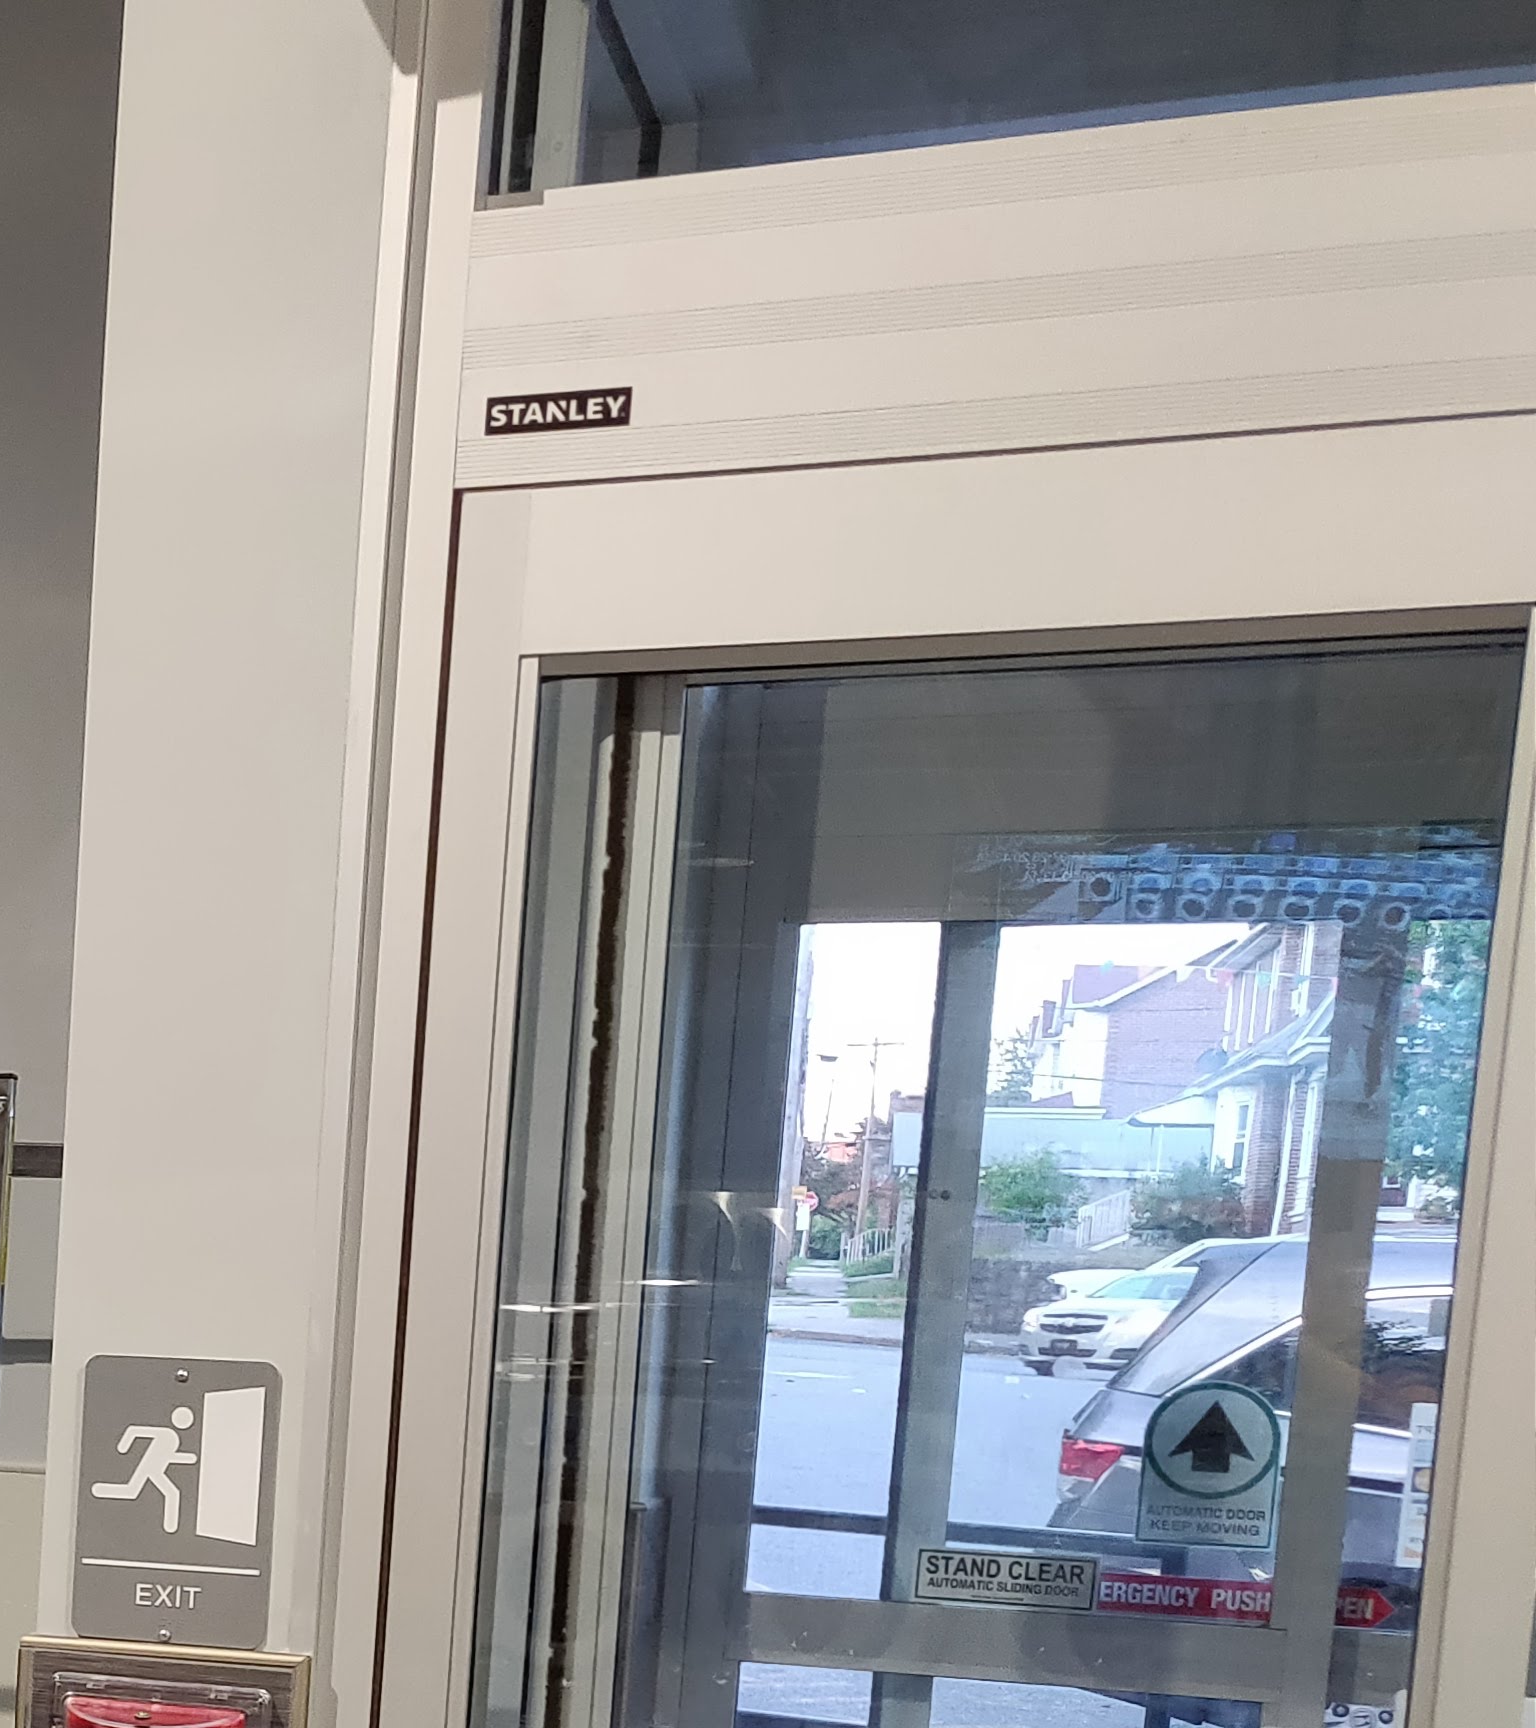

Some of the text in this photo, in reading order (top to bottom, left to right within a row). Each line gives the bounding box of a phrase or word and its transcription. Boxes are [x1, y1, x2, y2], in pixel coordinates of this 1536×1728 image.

[489, 395, 627, 427] STANLEY
[1146, 1505, 1266, 1520] AUTOMATIC DOOR
[1150, 1519, 1260, 1536] KEEP MOVING
[925, 1555, 1085, 1584] STAND CLEAR
[135, 1583, 202, 1609] EXIT
[927, 1577, 1079, 1597] AUTOMATIC SLIDING DOOR
[1099, 1581, 1201, 1609] ERGENCY
[1211, 1588, 1271, 1613] PUSH
